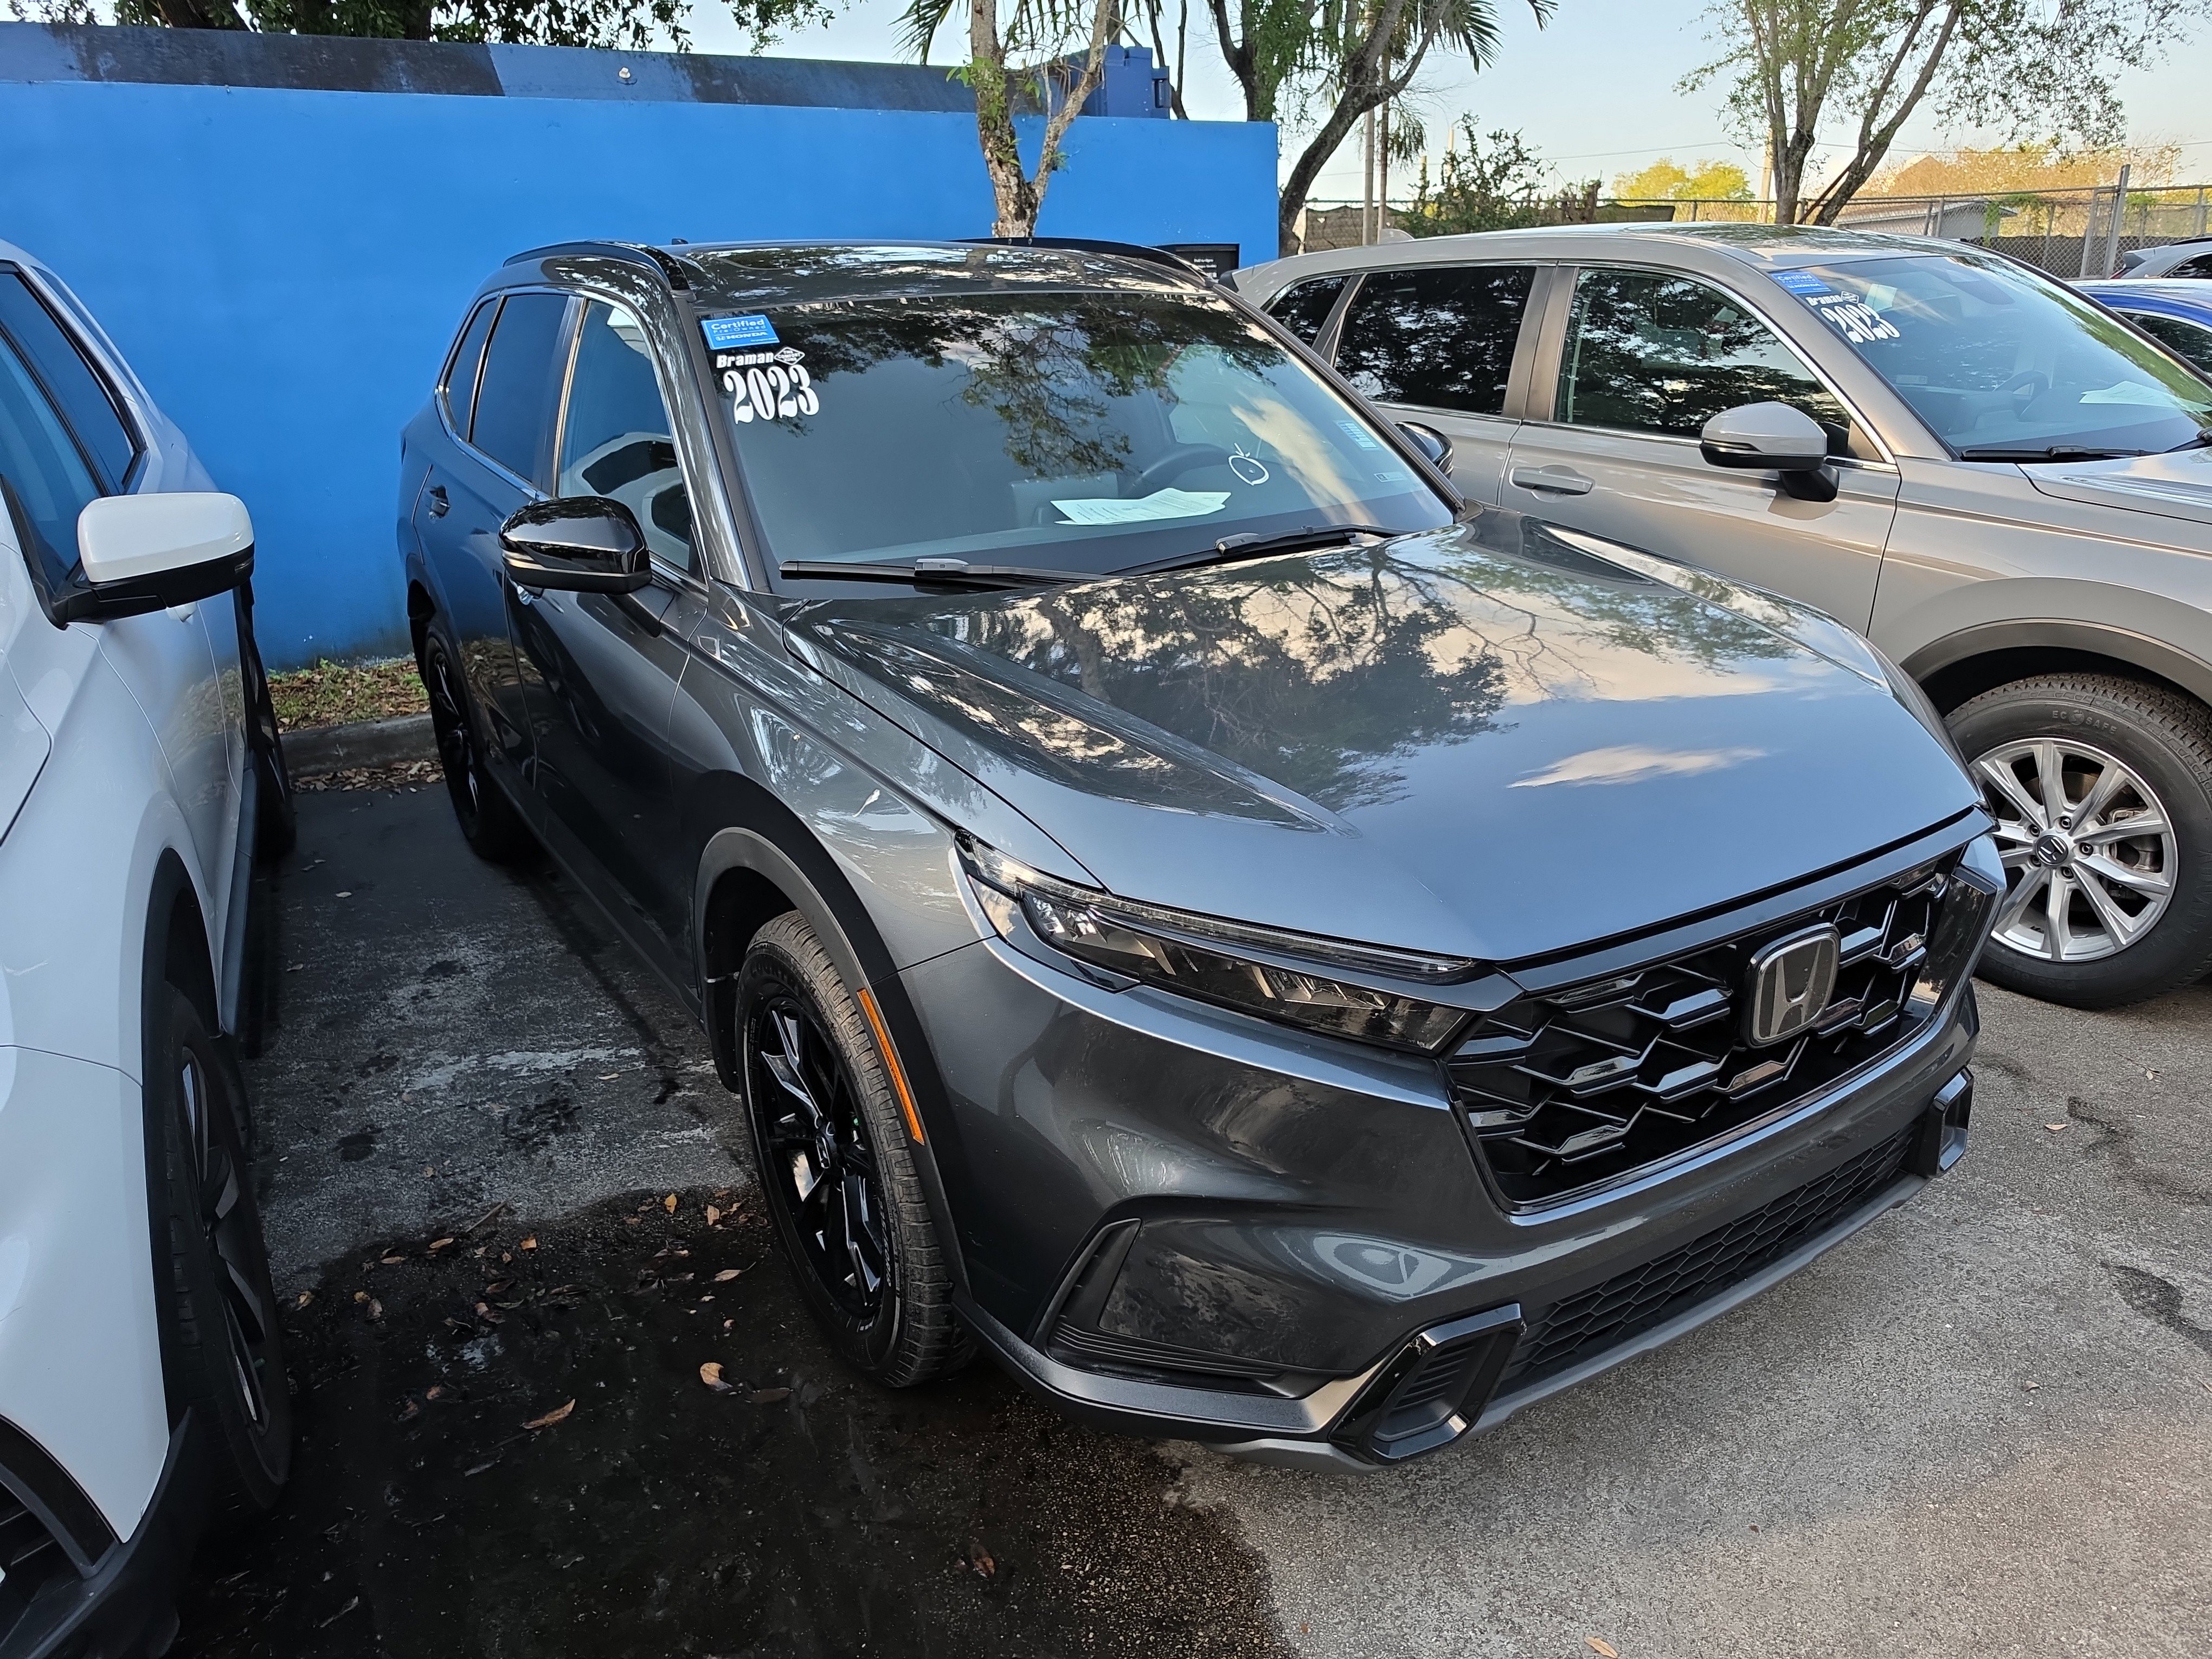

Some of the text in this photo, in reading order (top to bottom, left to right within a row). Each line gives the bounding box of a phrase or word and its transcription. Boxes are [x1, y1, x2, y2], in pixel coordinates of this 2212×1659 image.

[1805, 294, 1843, 306] Braman
[711, 319, 764, 330] Certified
[712, 325, 767, 334] Pre-Owned
[1820, 303, 1900, 344] 2023
[726, 332, 768, 340] HONDA
[716, 352, 774, 369] Braman
[723, 364, 819, 425] 2023
